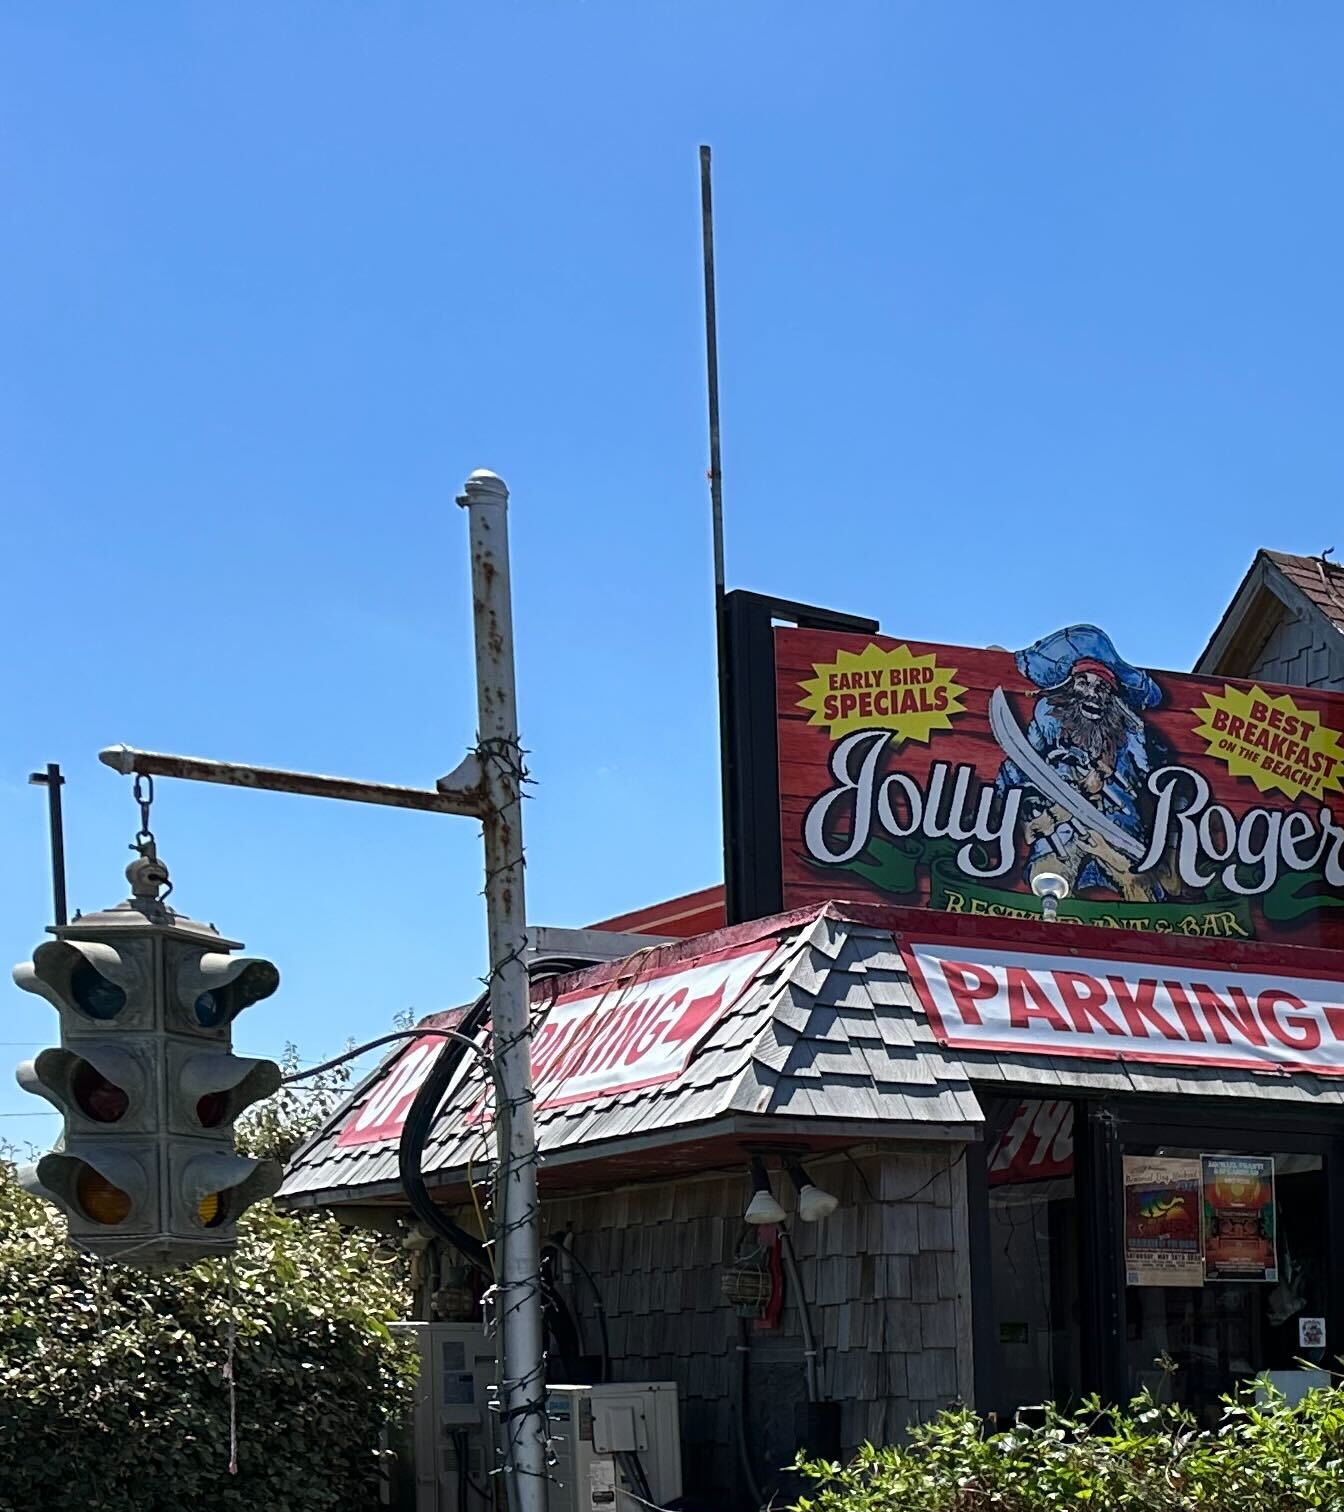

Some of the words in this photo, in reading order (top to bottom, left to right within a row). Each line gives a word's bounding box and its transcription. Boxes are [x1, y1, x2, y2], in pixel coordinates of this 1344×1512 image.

[829, 669, 883, 691] EARLY
[889, 667, 934, 687] BIRD
[823, 686, 949, 720] SPECIALS
[1250, 700, 1315, 741] BEST
[1211, 708, 1337, 778] BREAKFAST
[1218, 739, 1236, 753] ON
[1240, 747, 1261, 763] THE
[805, 731, 1022, 877] Jolly
[1177, 912, 1249, 937] BAR
[939, 959, 1322, 1051] PARKING
